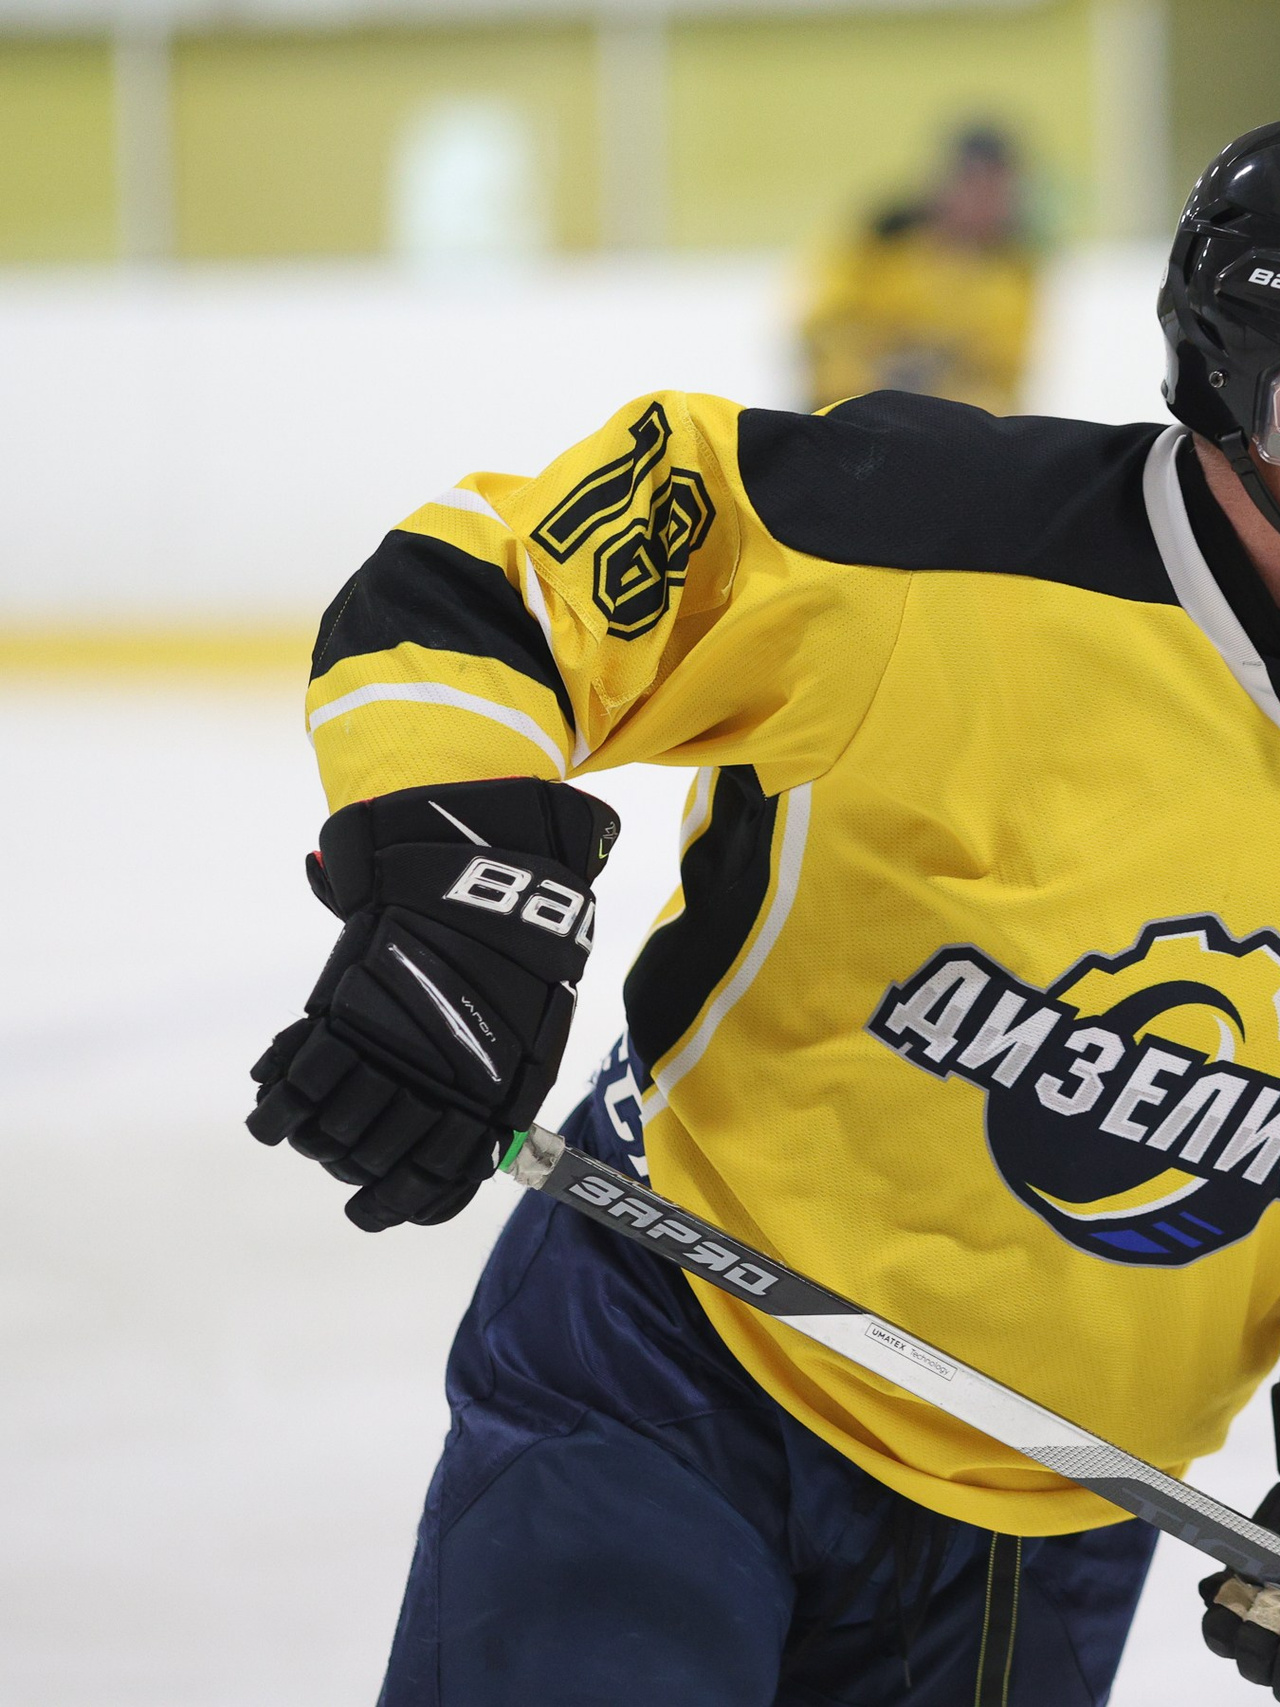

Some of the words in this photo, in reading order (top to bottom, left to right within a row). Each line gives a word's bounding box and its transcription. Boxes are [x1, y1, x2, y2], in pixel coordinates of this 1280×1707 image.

[529, 400, 716, 642] 18
[871, 1328, 907, 1351] UMATEX
[910, 1348, 950, 1376] Technology
